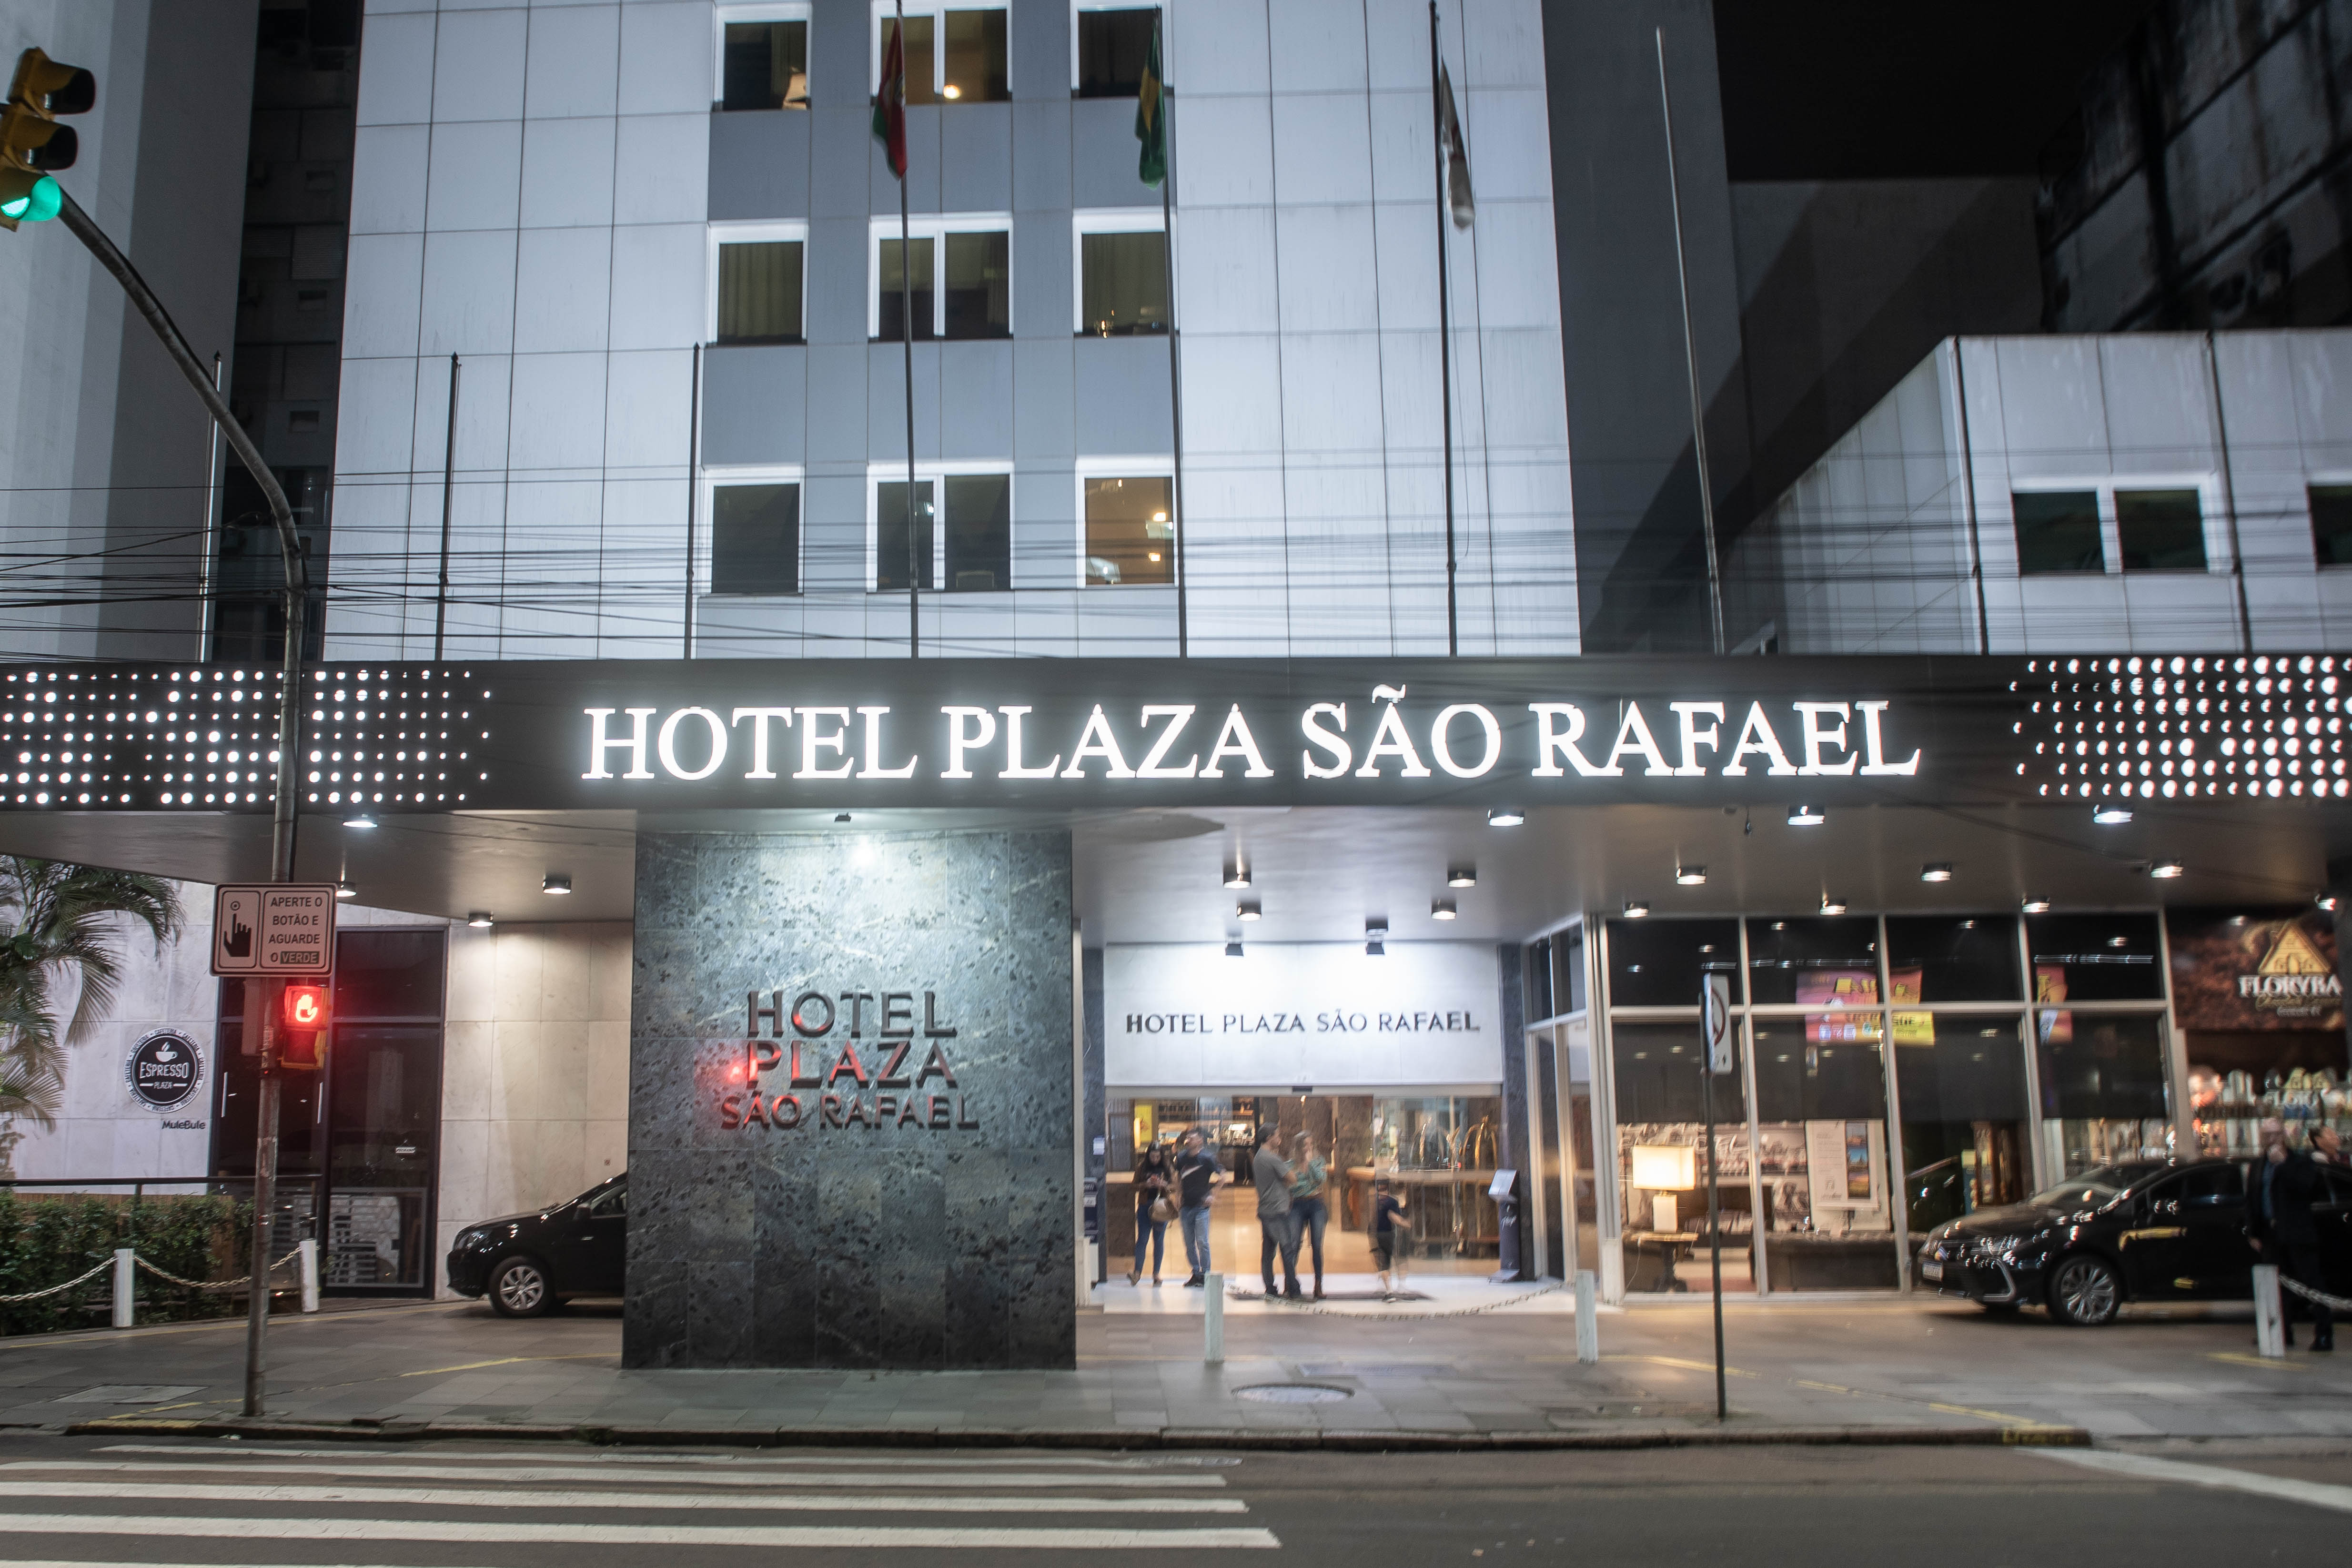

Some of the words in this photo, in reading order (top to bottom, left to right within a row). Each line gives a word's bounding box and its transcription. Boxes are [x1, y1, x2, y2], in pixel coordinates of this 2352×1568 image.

[582, 706, 918, 781] HOTEL
[940, 703, 1274, 780] PLAZA
[1301, 684, 1501, 779] SÃO
[1528, 699, 1921, 777] RAFAEL
[271, 897, 312, 907] APERTE
[315, 897, 322, 907] O
[273, 913, 309, 925] BOTÃO
[312, 915, 319, 925] E
[268, 934, 320, 944] AGUARDE
[271, 952, 278, 962] O
[282, 952, 317, 963] VERDE
[747, 991, 957, 1038] HOTEL
[1126, 1013, 1213, 1034] HOTEL
[1223, 1013, 1305, 1033] PLAZA
[1317, 1009, 1367, 1033] SÃO
[1378, 1011, 1481, 1032] RAFAEL
[140, 1062, 189, 1078] ESPRESSO
[746, 1039, 958, 1089] PLAZA
[721, 1091, 801, 1129] SÃO
[819, 1095, 979, 1129] RAFAEL
[162, 1120, 206, 1129] MuleBule
